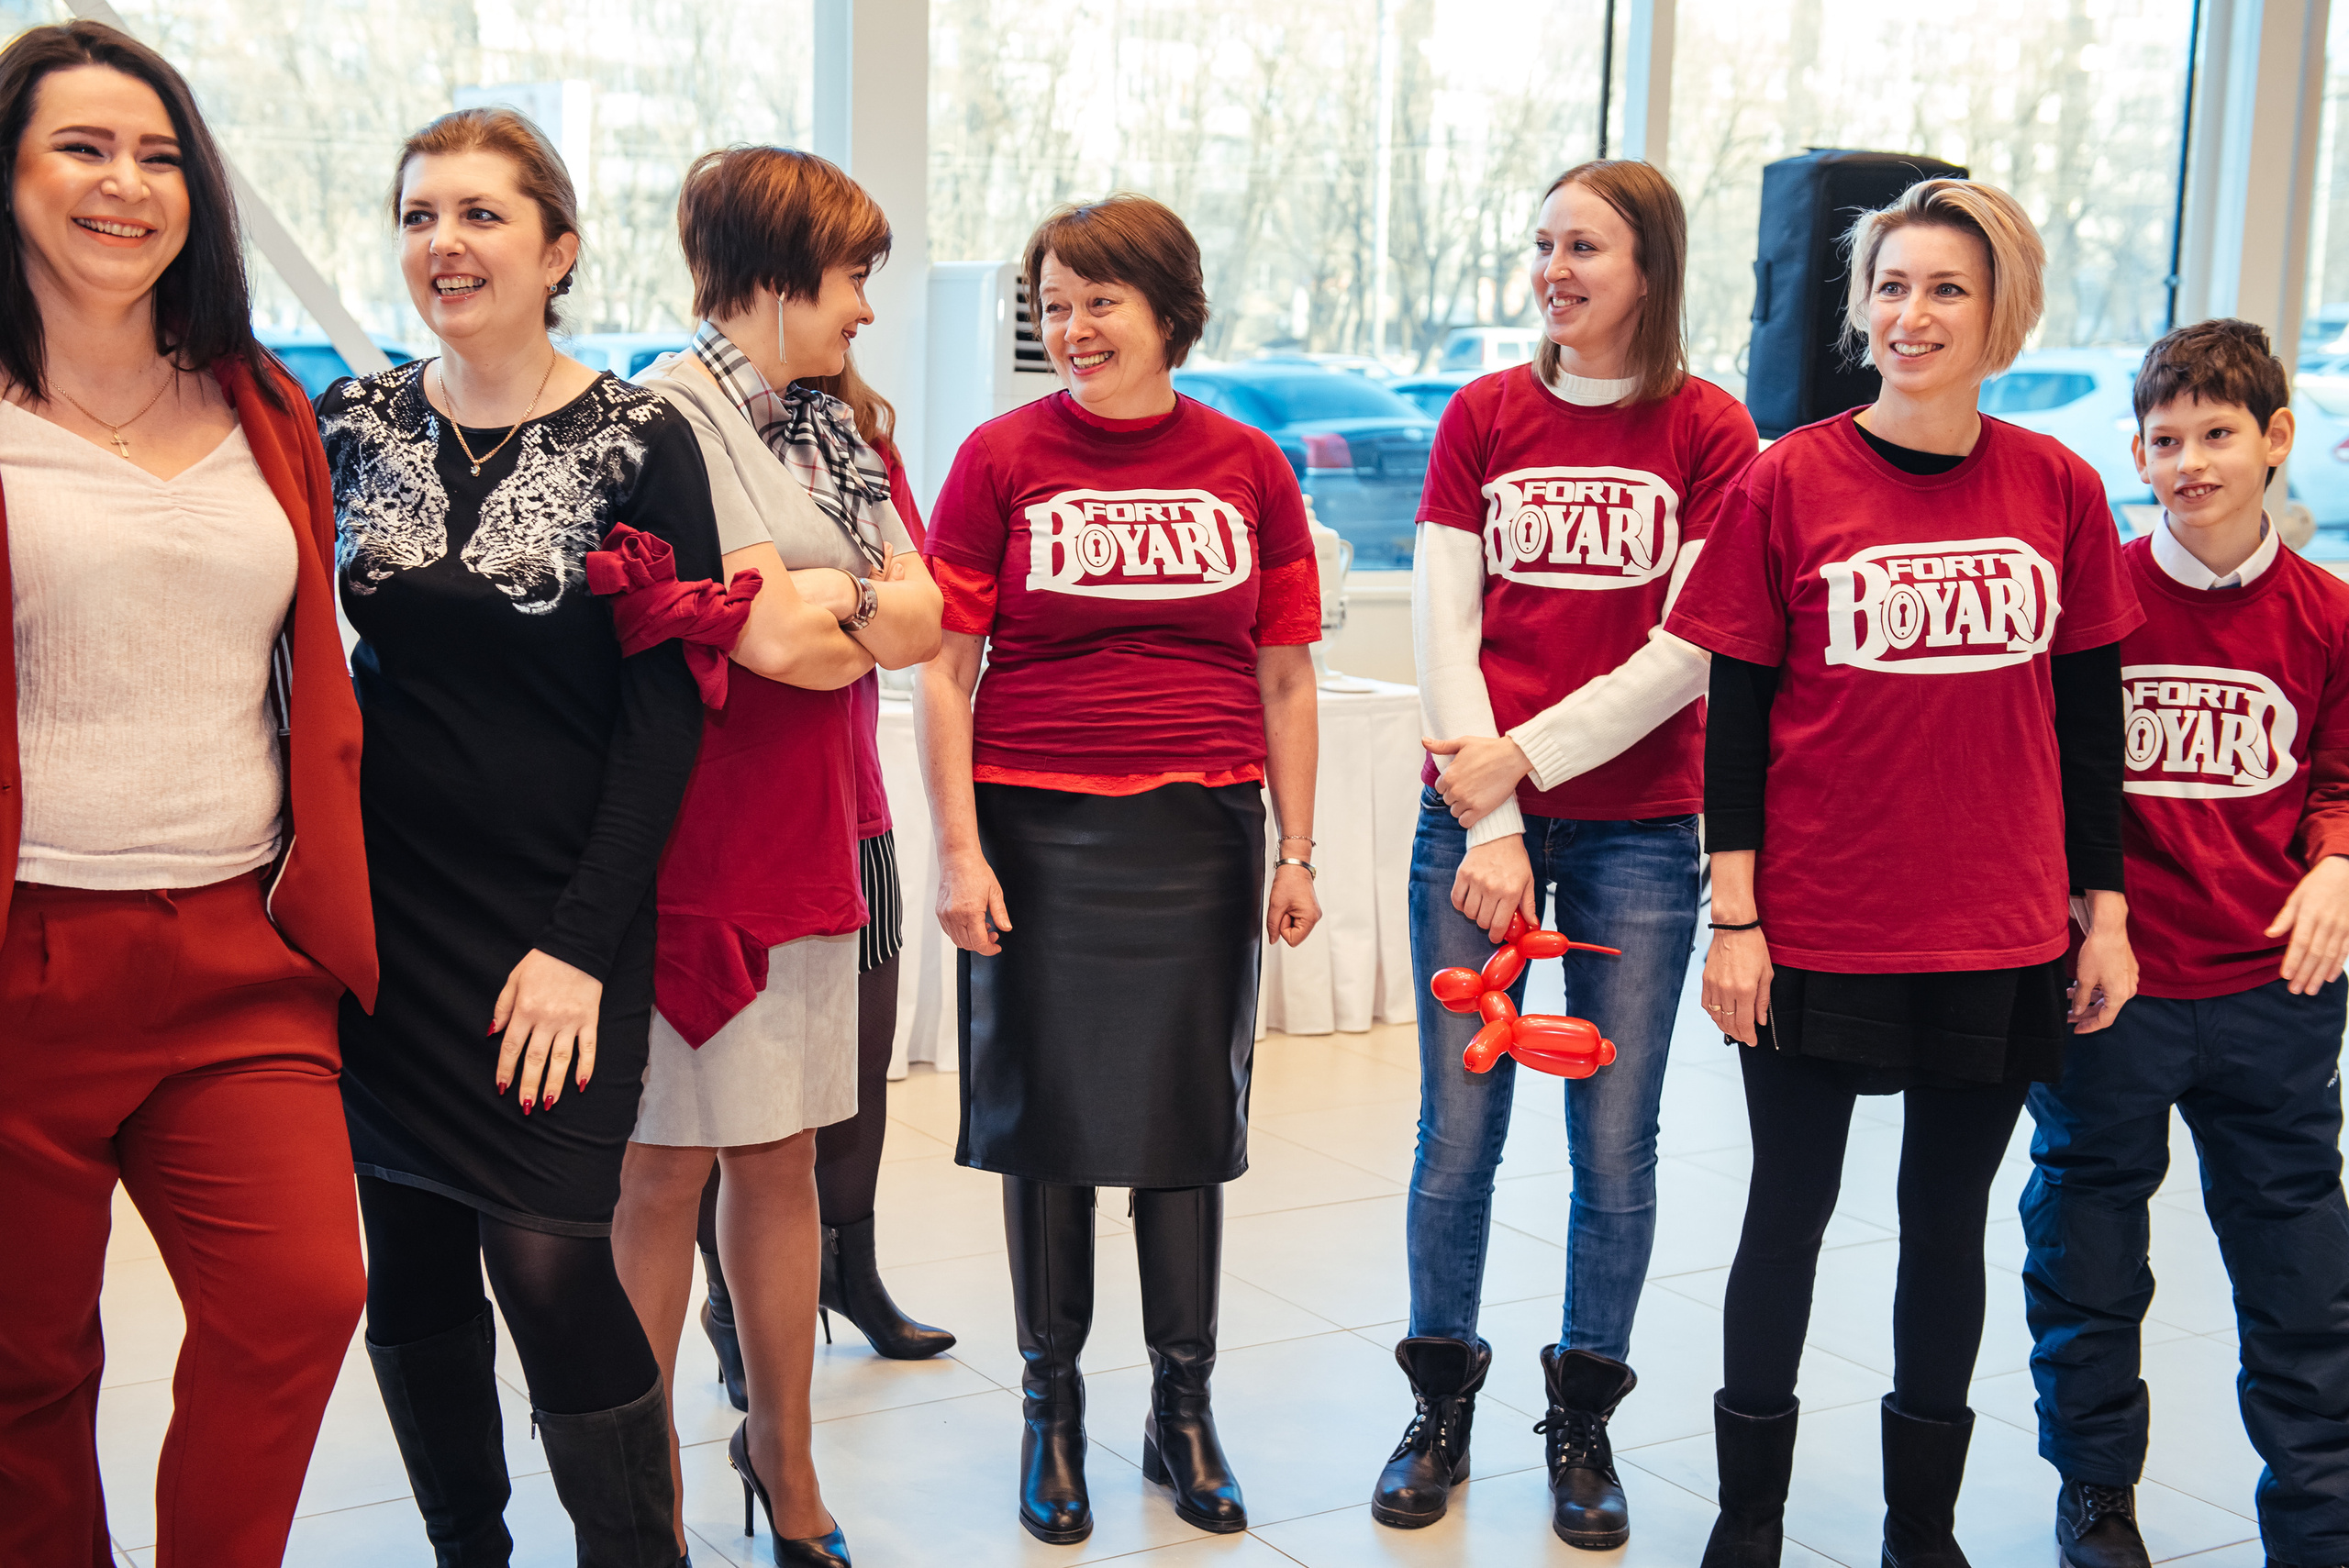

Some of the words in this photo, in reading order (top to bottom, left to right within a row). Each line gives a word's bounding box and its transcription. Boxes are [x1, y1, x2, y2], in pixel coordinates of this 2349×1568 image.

[1083, 501, 1186, 522] FORT
[1523, 481, 1628, 505] FORT
[1024, 500, 1252, 592] BOYARD
[1481, 482, 1679, 576] BOYARD
[1886, 553, 2003, 582] FORT
[1820, 553, 2062, 666] BOYARD
[2133, 681, 2247, 710] FORT
[2122, 685, 2299, 791] OYARD
